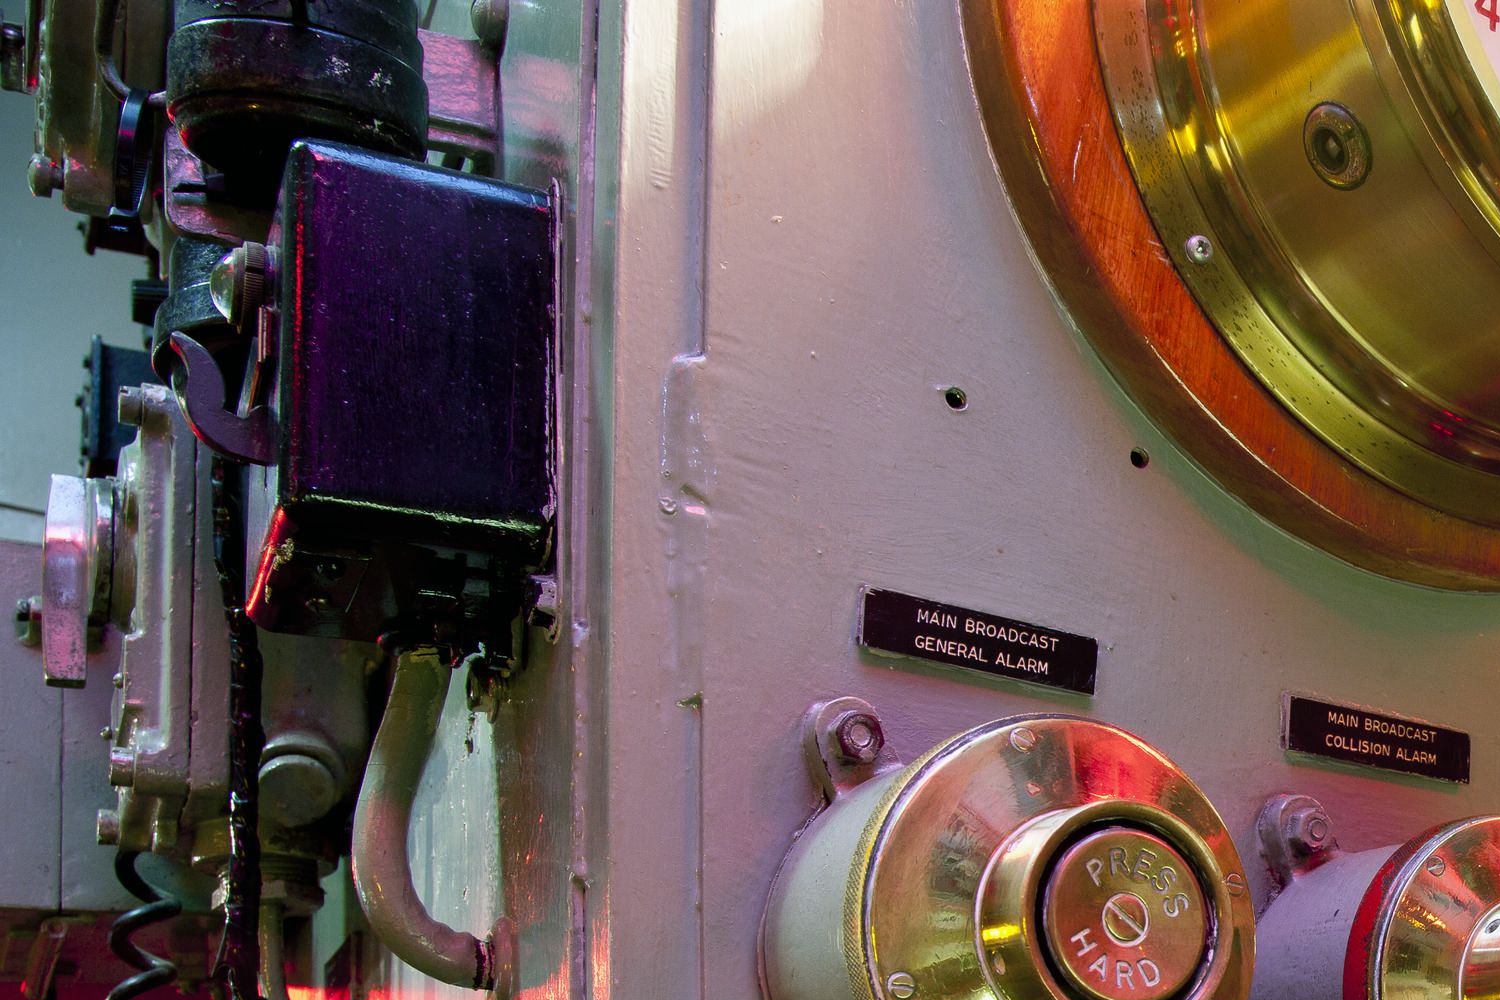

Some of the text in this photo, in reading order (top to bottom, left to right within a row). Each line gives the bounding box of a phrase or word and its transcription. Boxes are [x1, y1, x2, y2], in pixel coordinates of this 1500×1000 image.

[917, 608, 1059, 652] MAIN BROADCAST
[915, 635, 1048, 675] GENERAL ALARM
[1328, 711, 1437, 743] MAIN BROADCAST
[1325, 734, 1437, 766] COLLISION ALARM
[1085, 847, 1189, 918] PRESS
[1070, 928, 1161, 990] HARD
